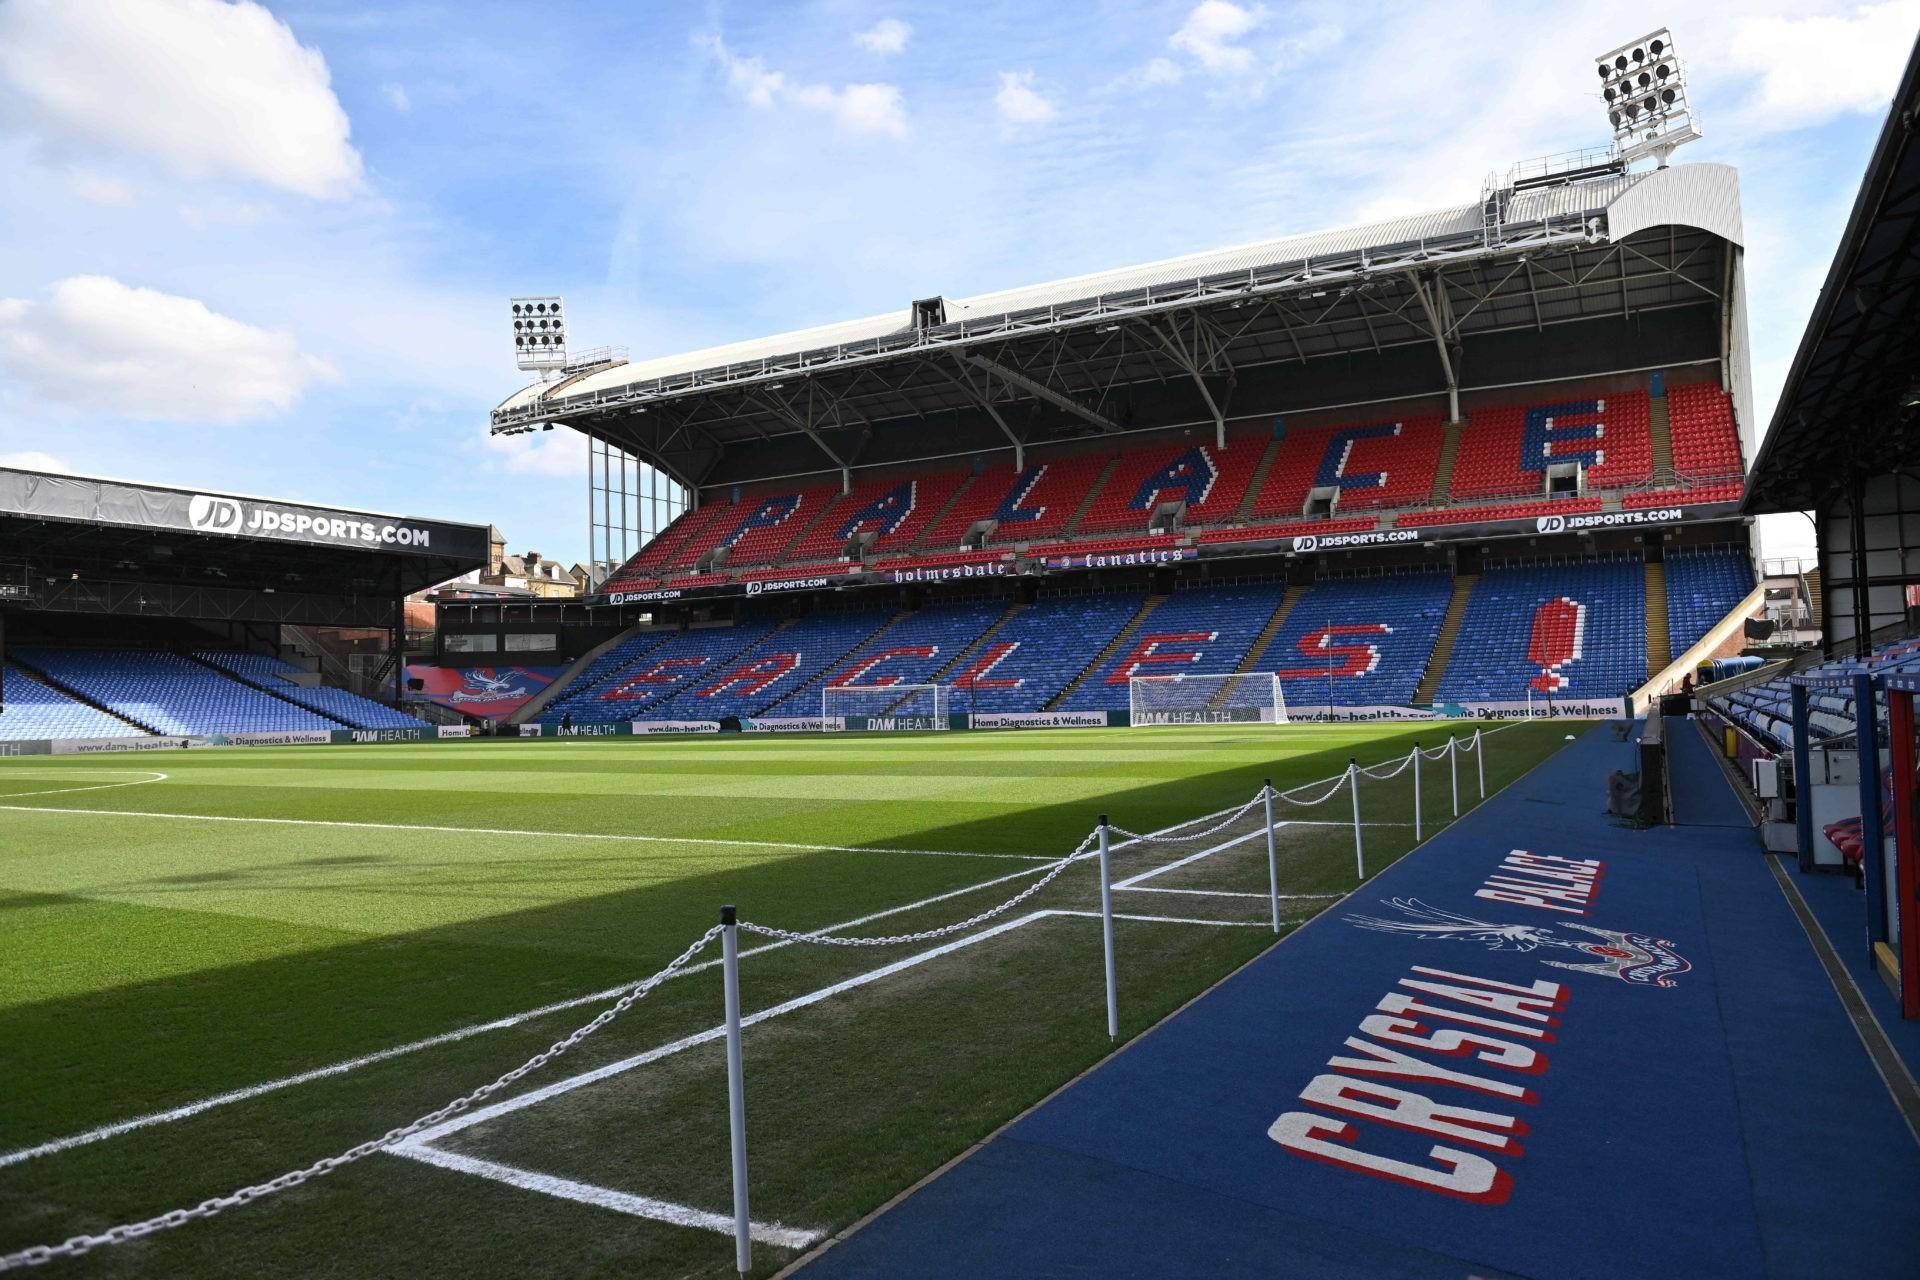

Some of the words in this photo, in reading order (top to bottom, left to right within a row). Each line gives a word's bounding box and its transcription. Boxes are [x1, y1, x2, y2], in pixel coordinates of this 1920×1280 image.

[195, 499, 238, 530] JD
[247, 509, 430, 547] JDSPORTS.COM
[1540, 515, 1562, 532] JD
[1566, 508, 1683, 529] JDSPORTS.COM
[1295, 536, 1315, 551] JD
[1318, 530, 1419, 548] JDSPORTS.COM
[1085, 548, 1184, 568] fanatics
[894, 561, 1005, 583] holmesdale
[762, 579, 827, 591] JDSPORTS.COM
[624, 591, 681, 602] JDSPORTS.COM
[1561, 705, 1618, 715] Wellness
[974, 718, 999, 727] Home
[1000, 717, 1051, 728] Diagnostics
[1053, 717, 1060, 725] &
[1061, 716, 1102, 724] Wellness
[1172, 711, 1231, 723] HEALTH
[580, 724, 616, 736] HEALTH
[759, 722, 800, 732] Diagnostics
[801, 722, 807, 730] &
[867, 718, 895, 730] DAM
[235, 735, 285, 747] Diagnostics
[285, 735, 291, 744] &
[292, 734, 327, 744] Wellness
[380, 729, 420, 741] HEALTH
[1267, 965, 1571, 1204] CRYSTAL
[1474, 849, 1606, 917] PALACE
